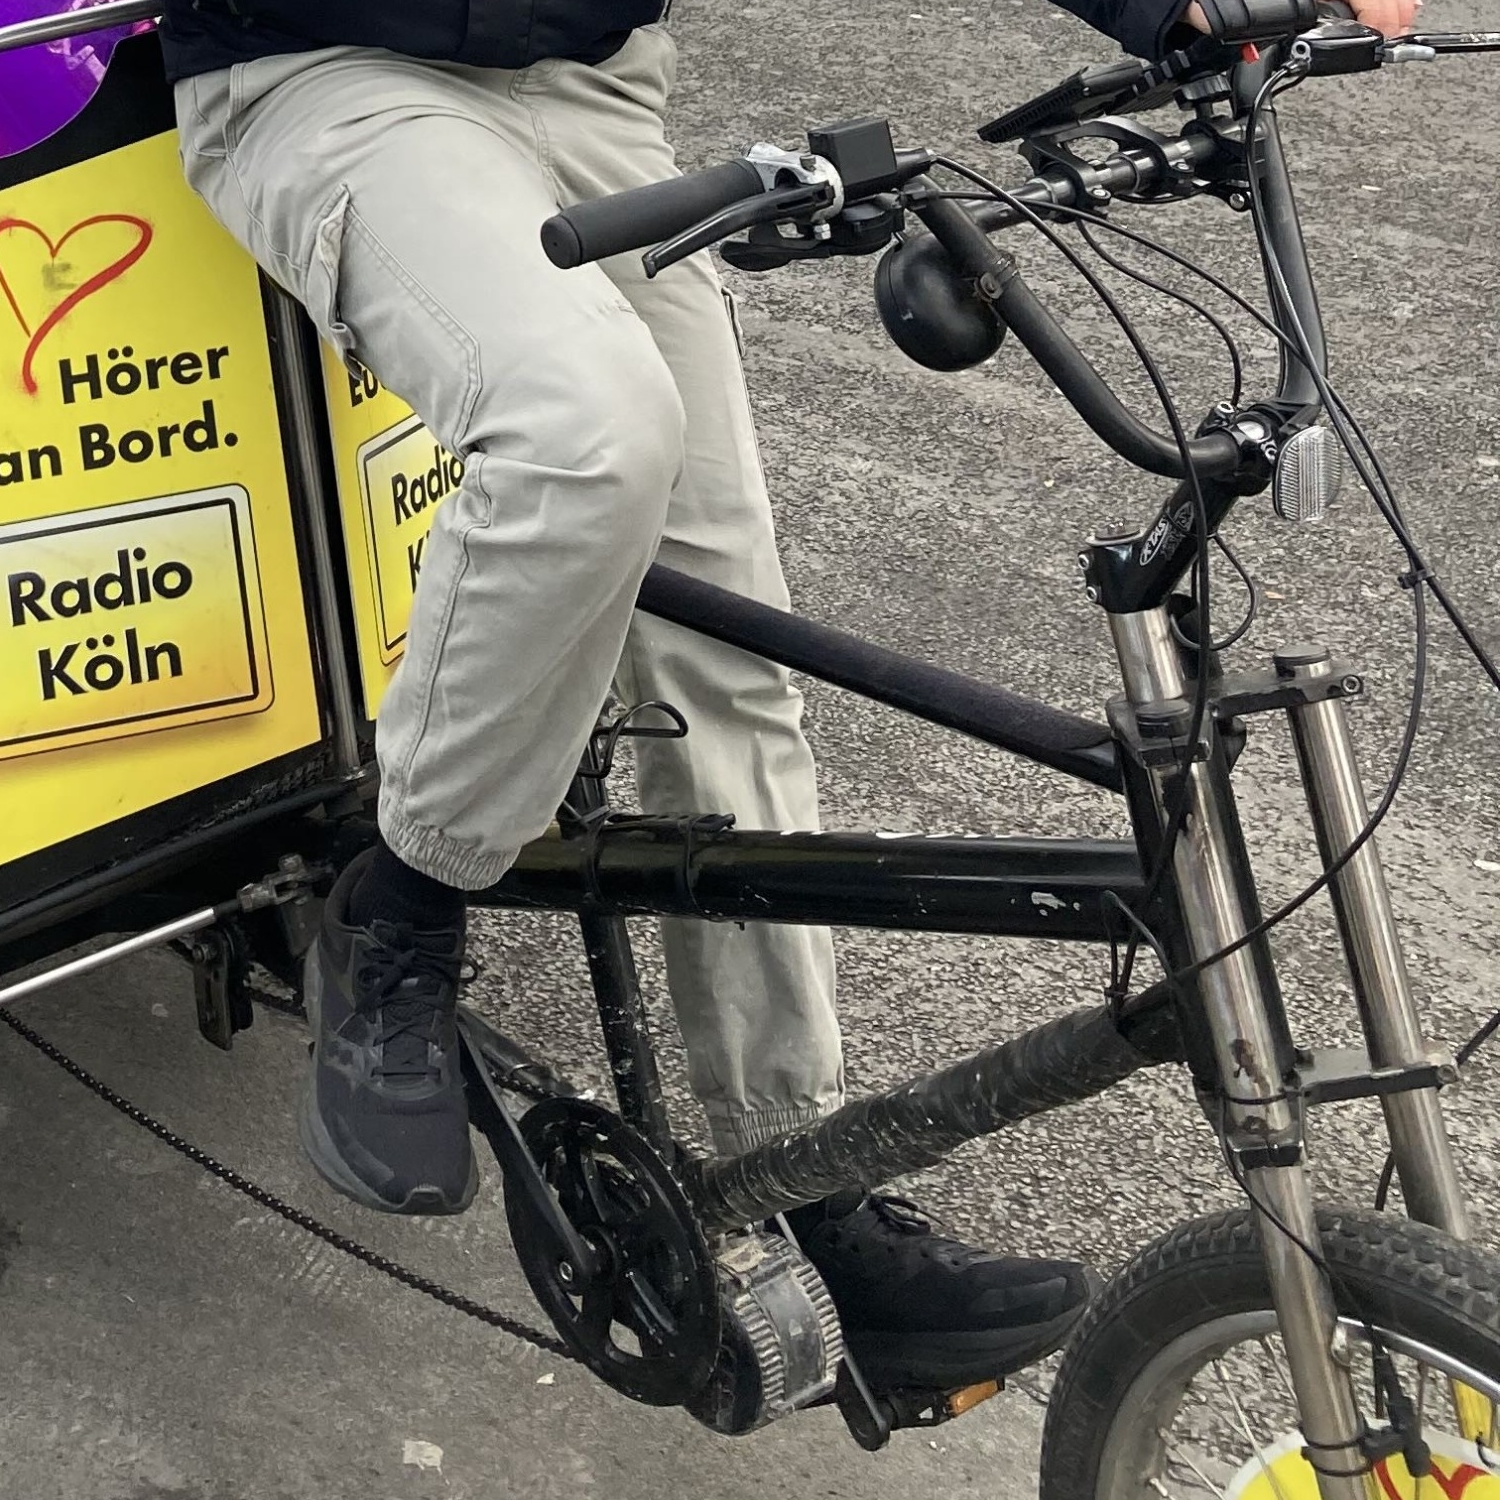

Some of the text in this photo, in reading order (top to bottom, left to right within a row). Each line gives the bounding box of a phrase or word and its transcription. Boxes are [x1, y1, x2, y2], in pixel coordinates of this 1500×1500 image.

[58, 345, 229, 405] Hörer
[78, 399, 239, 472] Bord.
[390, 443, 465, 527] Radio
[7, 546, 193, 628] Radio
[37, 627, 184, 701] Köln
